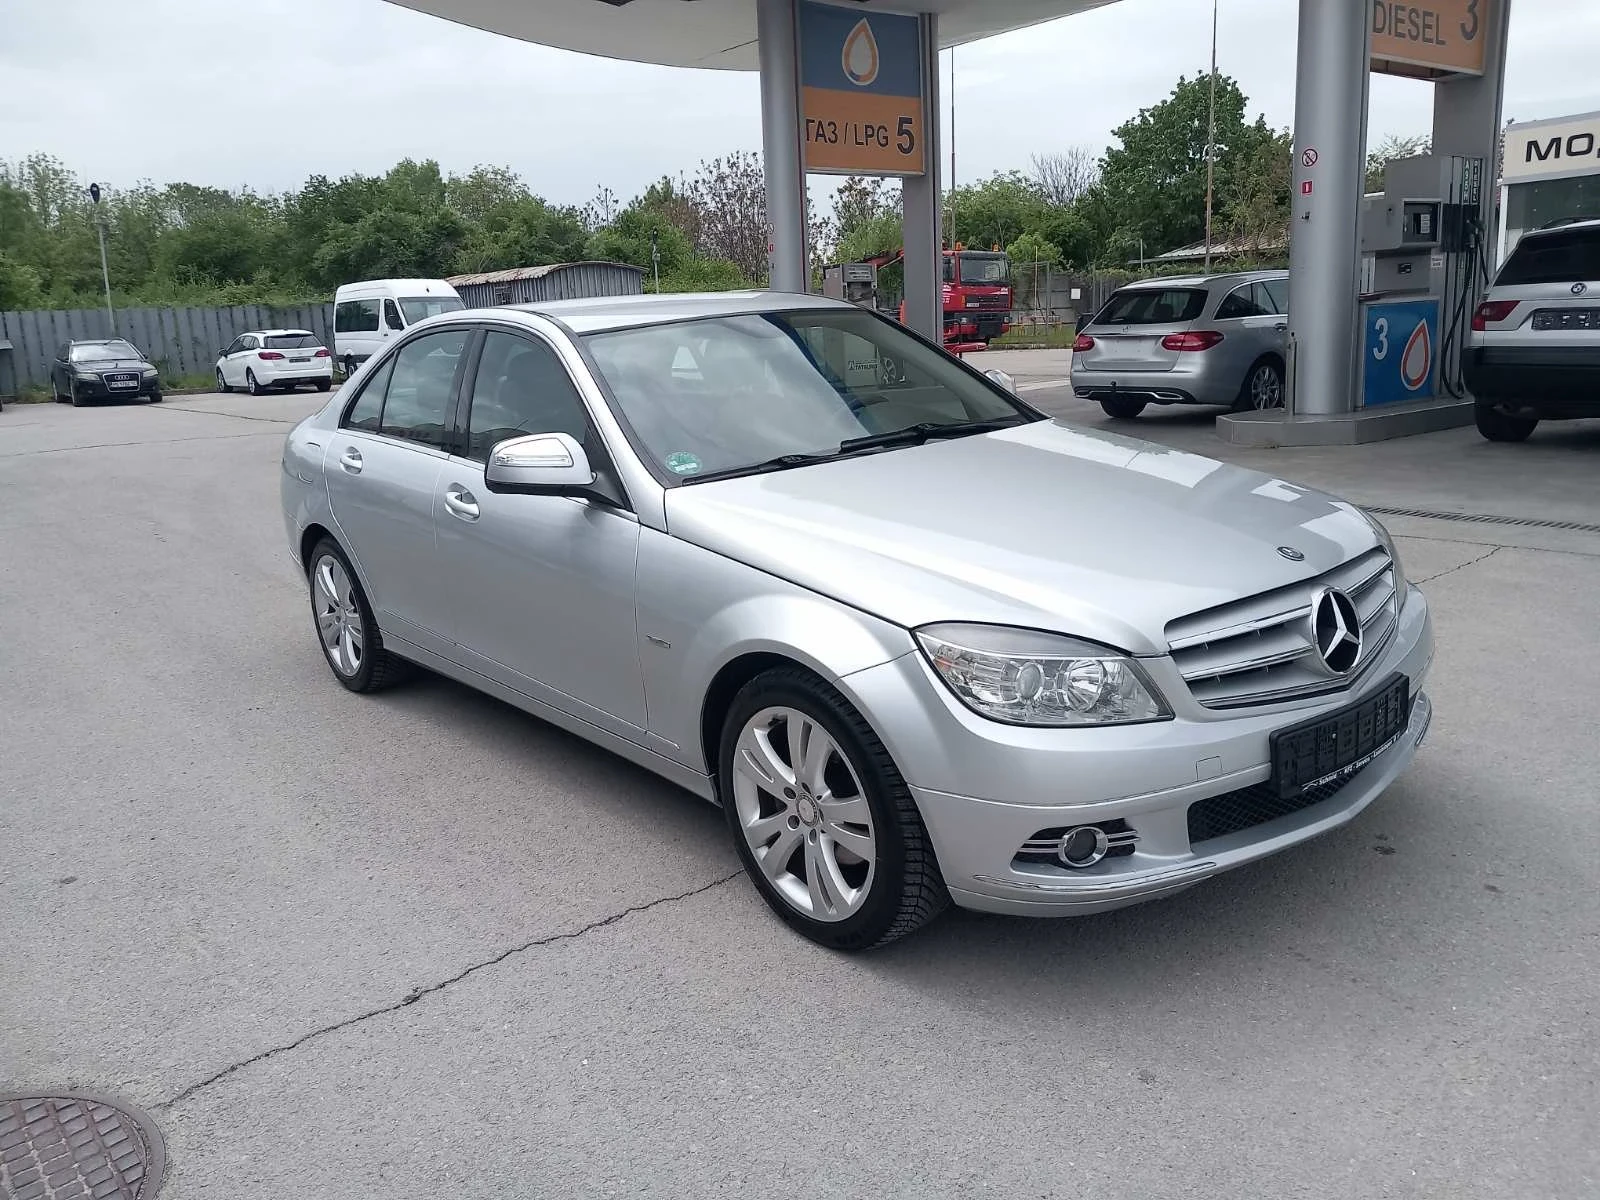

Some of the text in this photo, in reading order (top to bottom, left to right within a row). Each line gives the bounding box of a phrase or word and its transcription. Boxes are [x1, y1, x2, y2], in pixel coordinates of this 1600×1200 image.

[1373, 0, 1478, 45] DIESEL 3
[805, 118, 839, 145] ГАЗ
[853, 123, 889, 147] LPG
[896, 116, 915, 155] 5
[1373, 317, 1389, 360] 3
